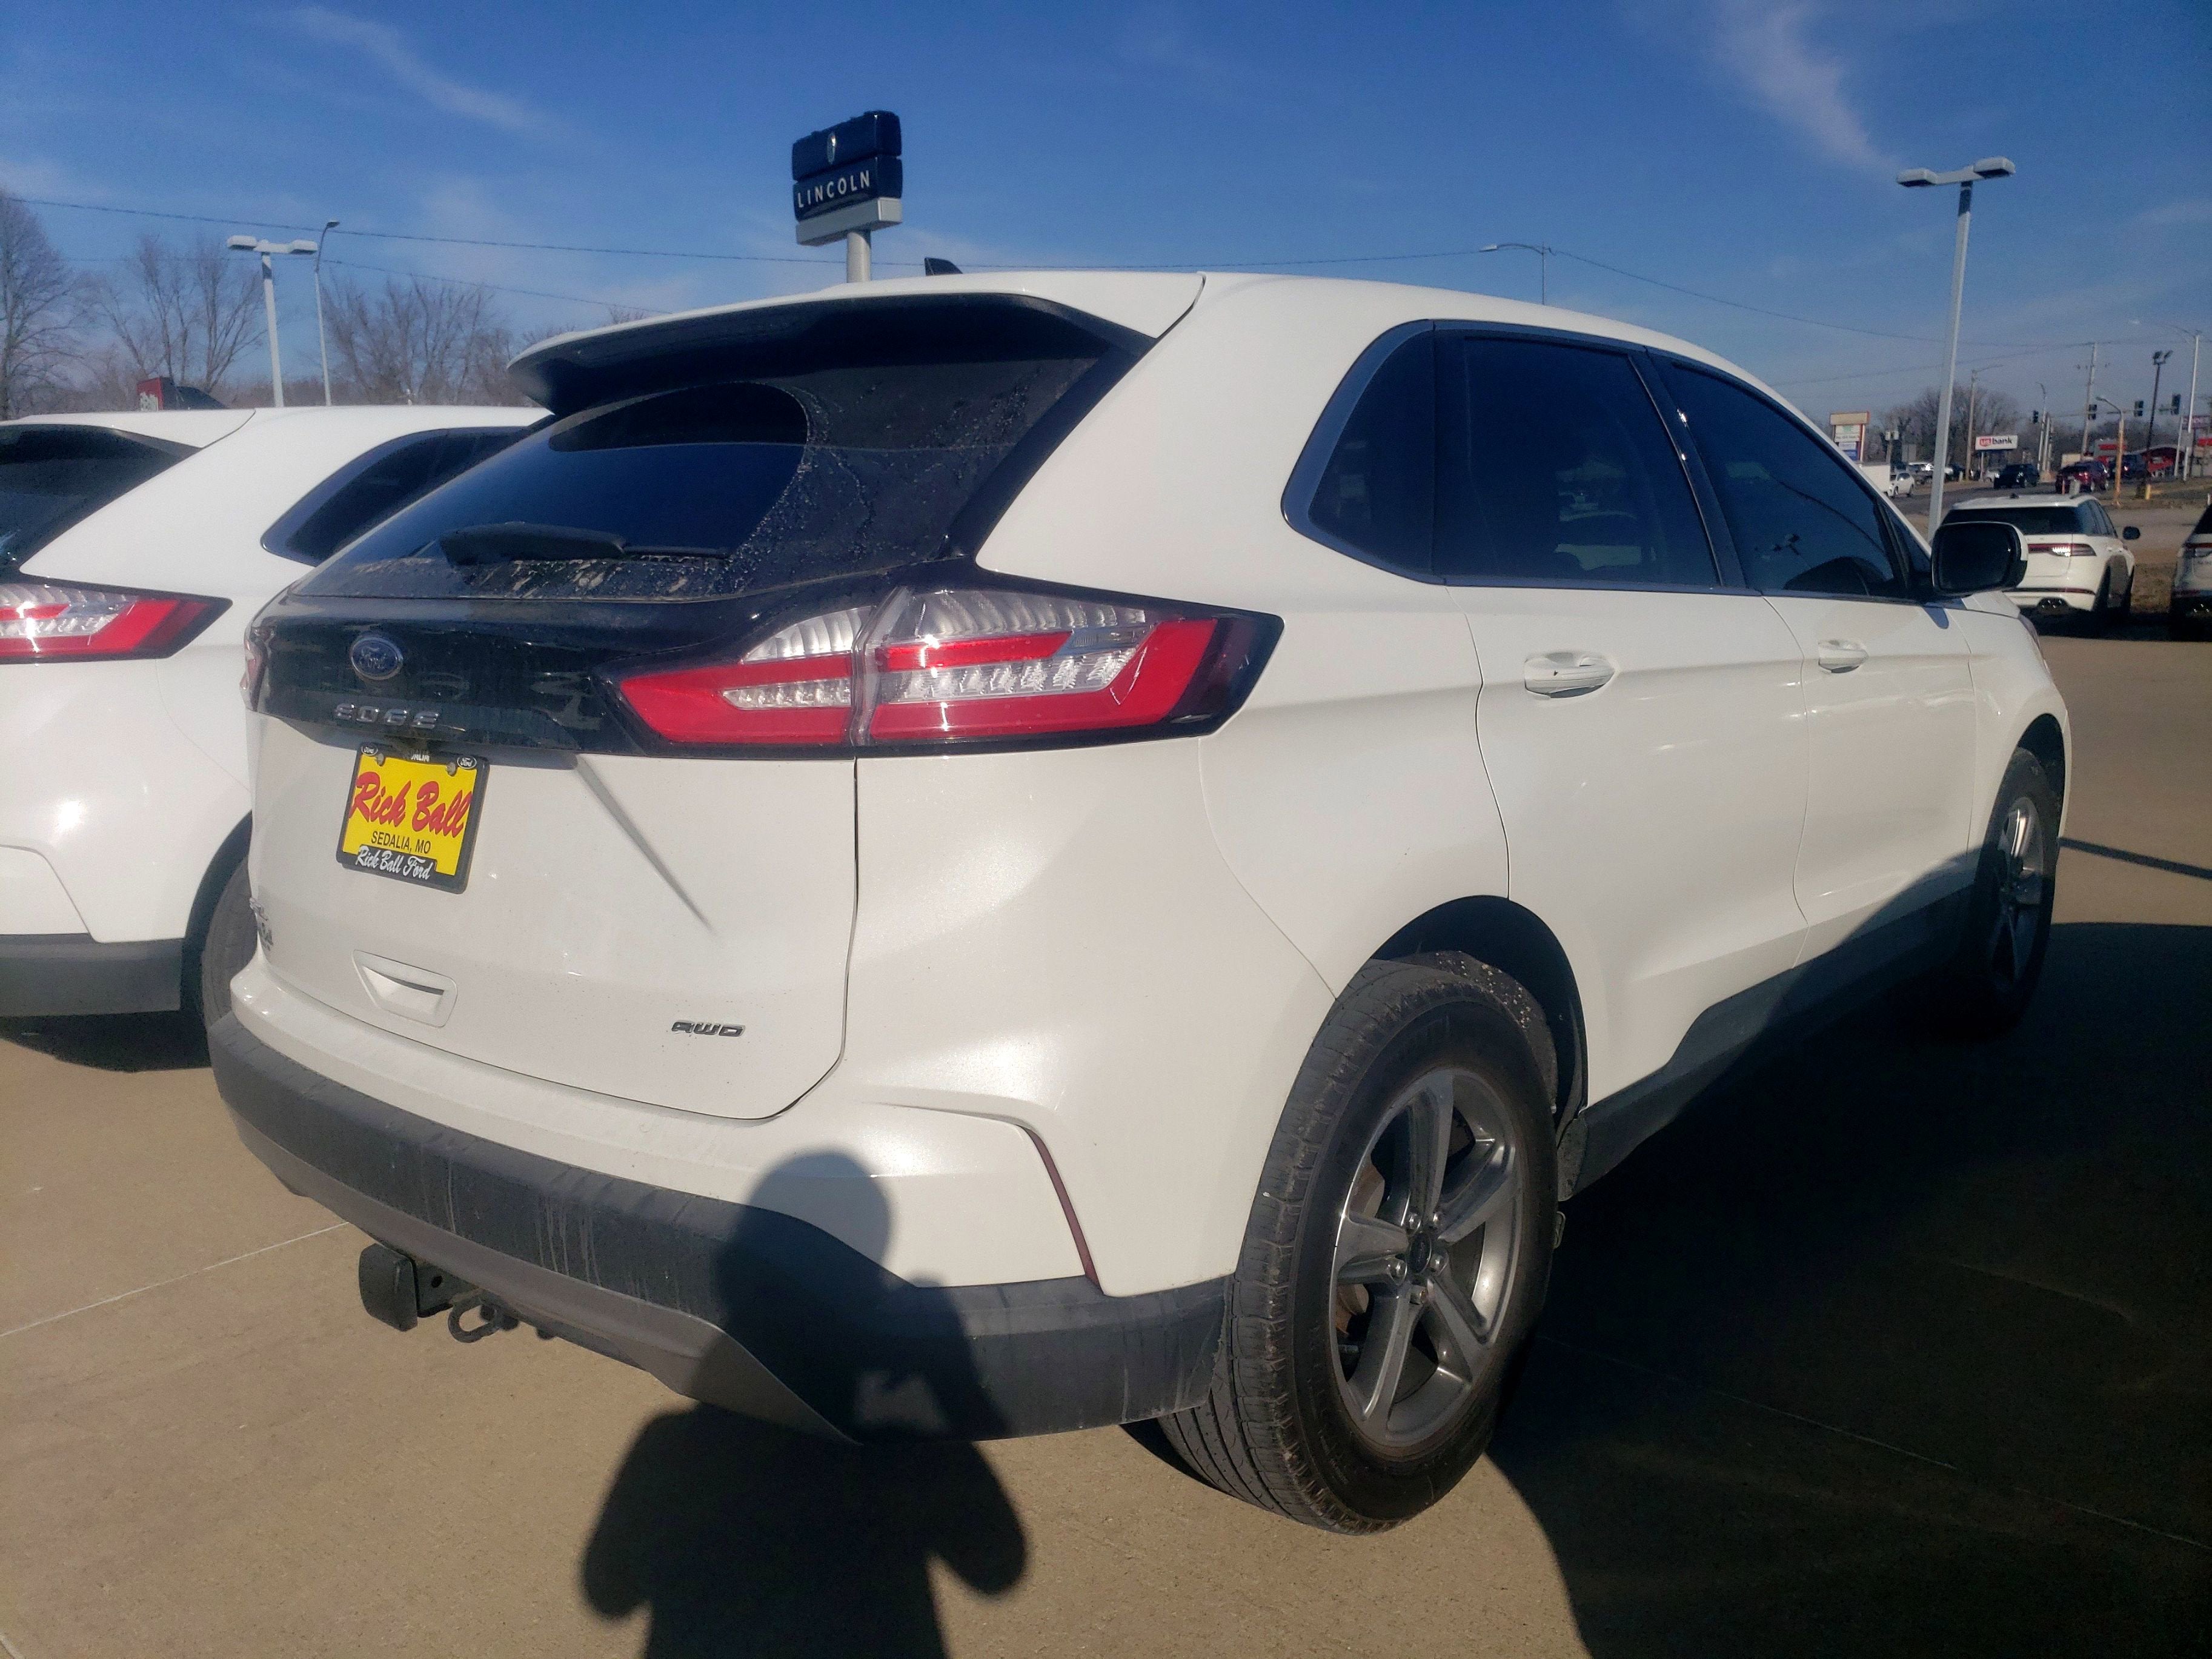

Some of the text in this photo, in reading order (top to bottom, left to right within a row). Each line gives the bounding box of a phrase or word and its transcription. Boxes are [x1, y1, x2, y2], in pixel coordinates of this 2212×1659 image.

[797, 170, 870, 208] LINCOLN
[334, 703, 439, 730] EDGE
[349, 771, 473, 838] Rich Ball
[371, 830, 431, 854] SEDALIA, MO
[355, 845, 433, 880] Rich Ball Ford
[671, 1020, 746, 1037] AWD
